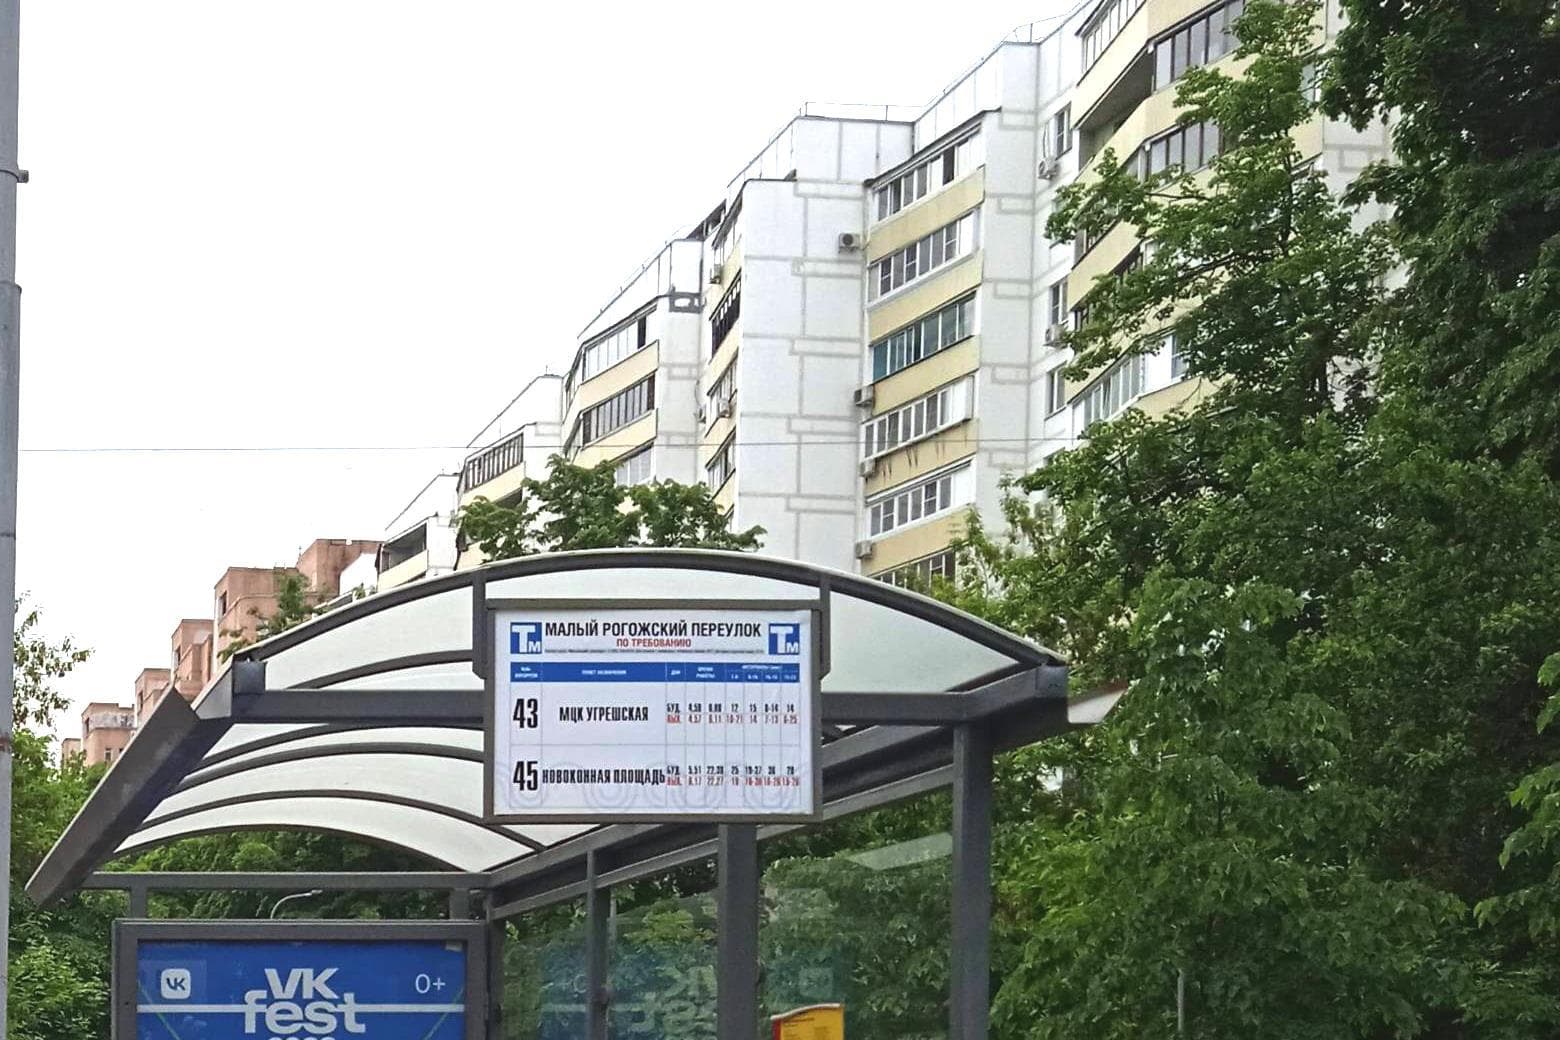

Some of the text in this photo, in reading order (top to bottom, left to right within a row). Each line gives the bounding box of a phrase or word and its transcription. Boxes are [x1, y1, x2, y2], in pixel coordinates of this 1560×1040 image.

[545, 619, 762, 637] МАЛЫЙ РОГОЖСКИЙ ПЕРЕУЛОК
[616, 638, 692, 648] ПО ТРЕБОВАНИЮ
[513, 698, 649, 729] 43 МЦК УГРЕШСКАЯ
[513, 761, 665, 791] 45 НОВОКОННАЯ ПЛОЩАДЬ
[264, 967, 340, 1000] VK
[415, 973, 446, 994] 0+
[243, 989, 366, 1034] fest
